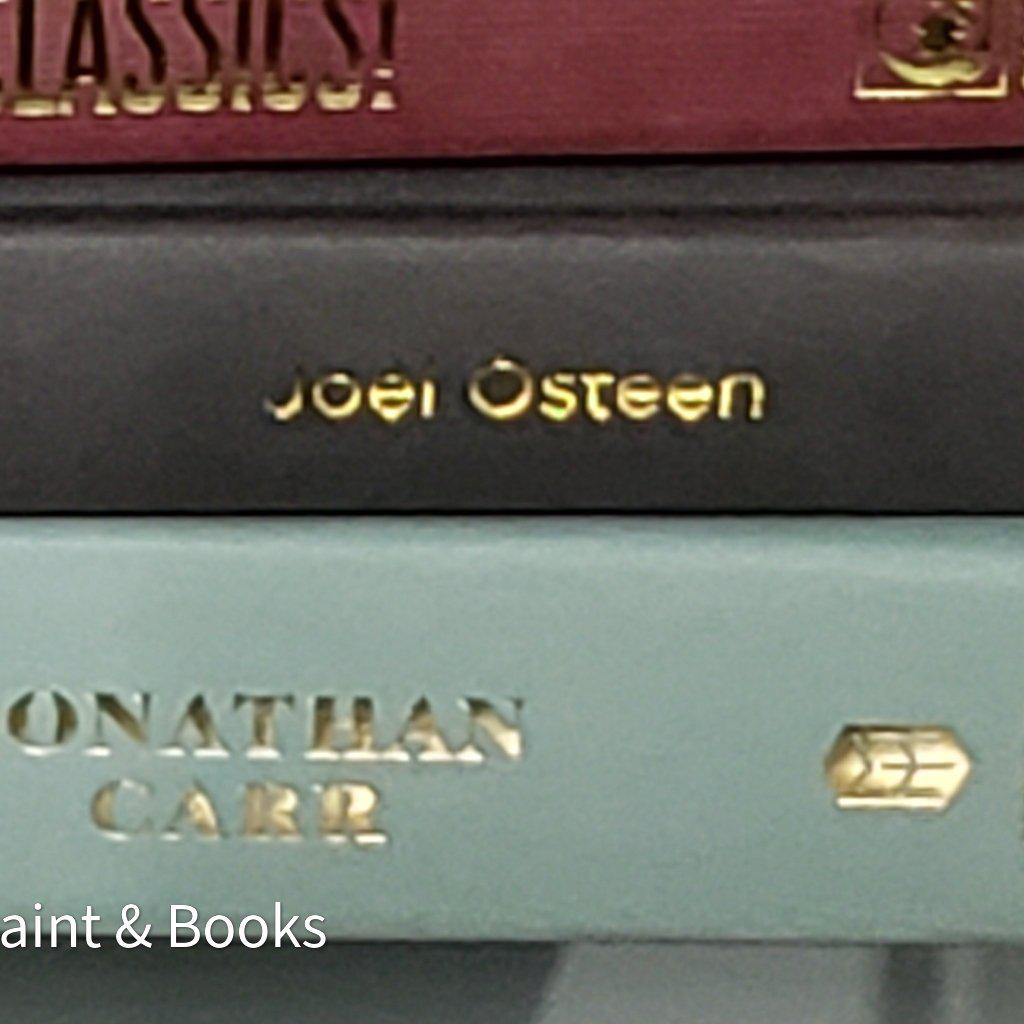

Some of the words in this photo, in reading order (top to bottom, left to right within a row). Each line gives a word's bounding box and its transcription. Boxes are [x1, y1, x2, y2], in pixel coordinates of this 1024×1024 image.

[264, 358, 435, 421] Joel
[468, 357, 765, 422] Osteen
[90, 779, 388, 844] CARR
